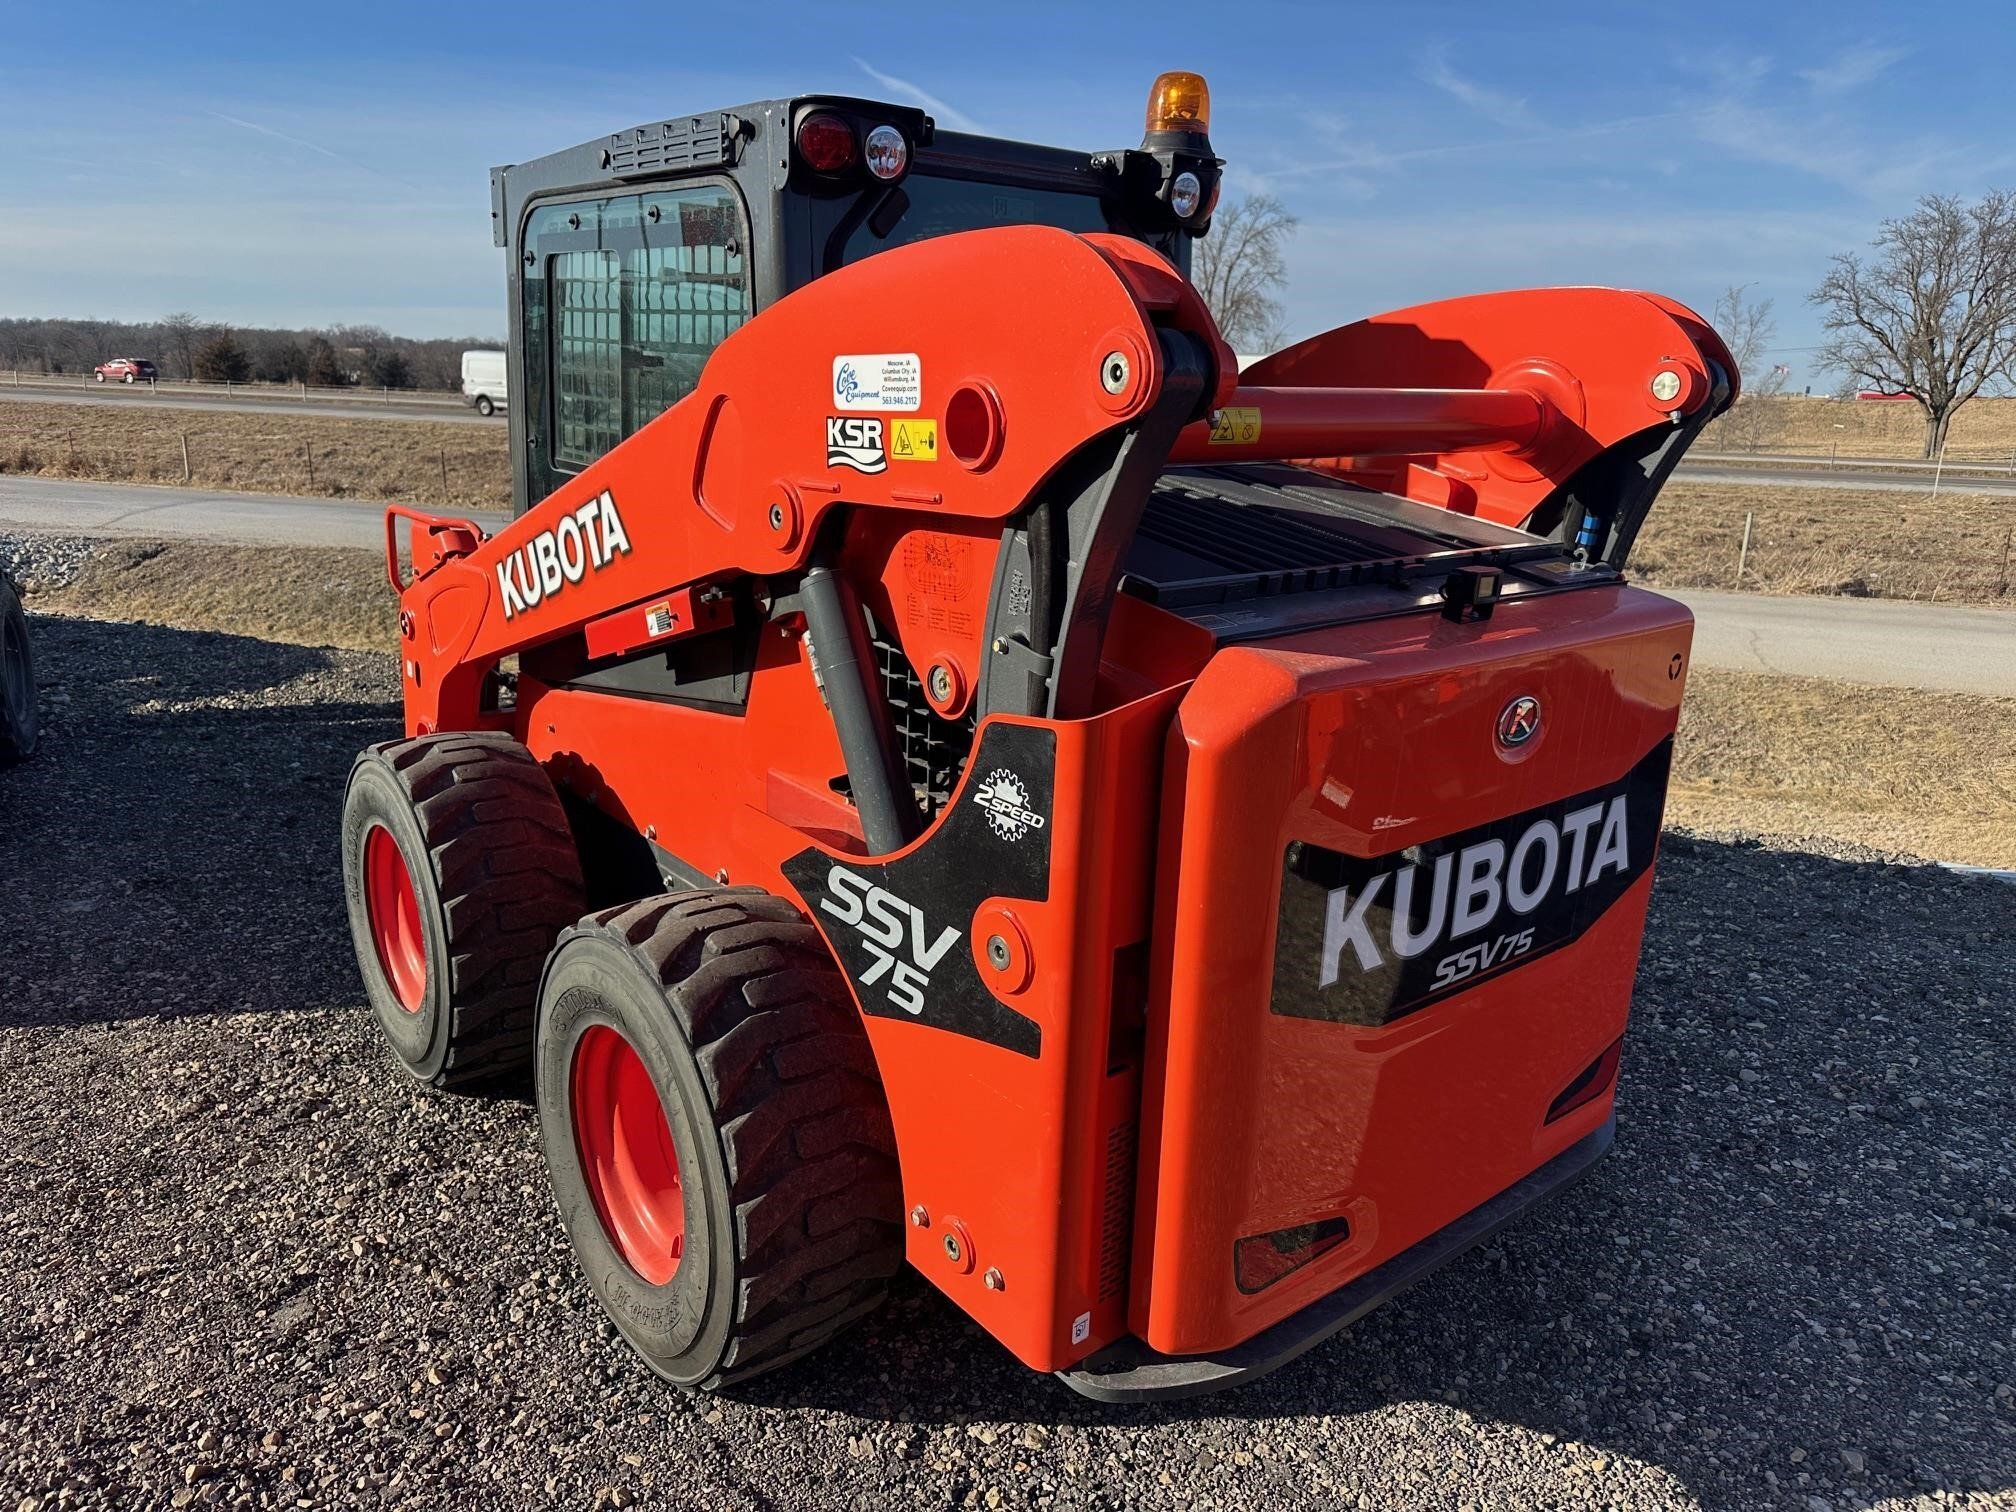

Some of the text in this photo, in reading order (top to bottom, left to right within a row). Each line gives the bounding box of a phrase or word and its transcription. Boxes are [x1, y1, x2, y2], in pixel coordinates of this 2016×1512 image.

[836, 362, 856, 395] Cove
[845, 386, 880, 403] Equipment
[881, 384, 918, 393] Coveequip.com
[882, 396, 918, 405] 563.946.2112
[827, 418, 883, 449] KSR
[495, 489, 633, 620] KUBOTA
[1318, 793, 1630, 992] KUBOTA
[820, 865, 963, 972] SSV
[858, 938, 930, 1015] 75
